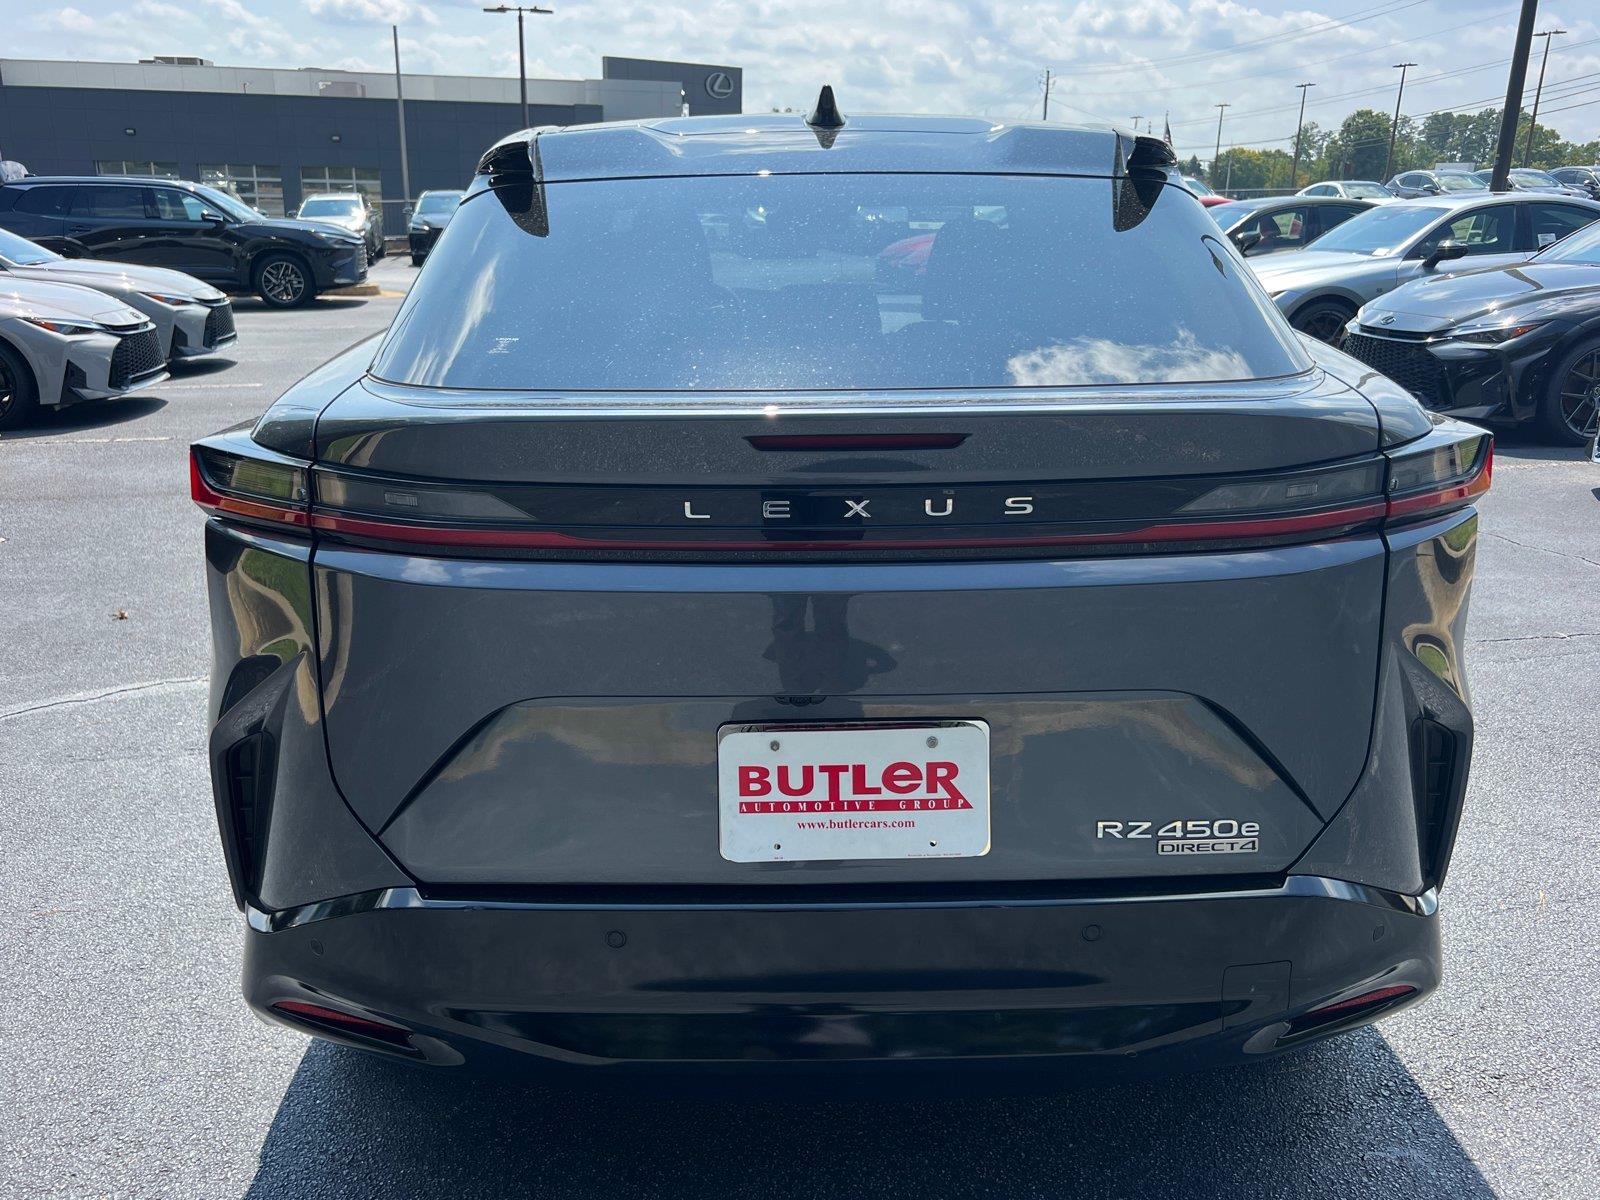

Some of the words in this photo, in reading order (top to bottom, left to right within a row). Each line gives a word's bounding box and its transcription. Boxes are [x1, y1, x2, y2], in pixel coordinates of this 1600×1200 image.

[684, 497, 1034, 519] LEXUS
[740, 800, 876, 812] AUTOMOTIVE
[899, 799, 965, 810] GROUP
[797, 818, 916, 830] www.butlercars.com
[1097, 821, 1152, 839] RZ
[1157, 819, 1260, 838] 450e
[1161, 840, 1257, 853] DIRECT4
